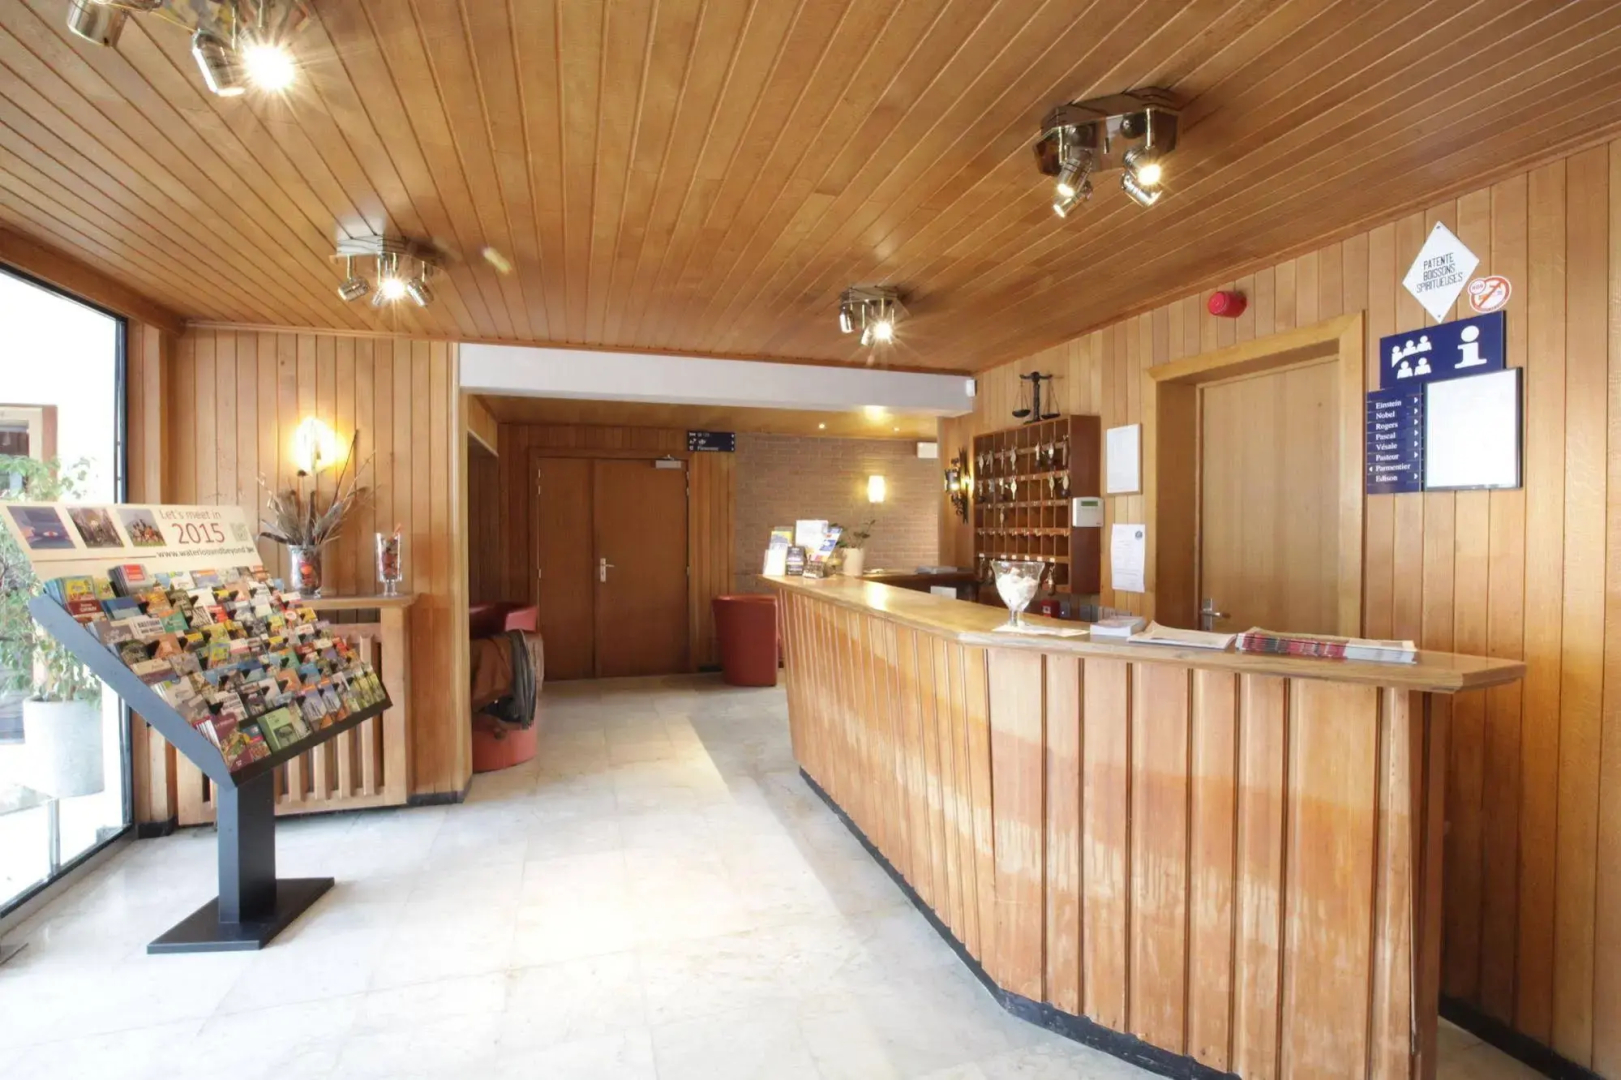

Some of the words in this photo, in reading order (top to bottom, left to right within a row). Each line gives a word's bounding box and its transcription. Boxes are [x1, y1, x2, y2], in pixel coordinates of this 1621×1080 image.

[1423, 252, 1454, 270] PATENTE
[1423, 263, 1455, 281] BOISSONS
[1416, 272, 1463, 293] SPIRITUEUSES
[1375, 400, 1402, 410] Einstein
[1375, 411, 1396, 420] Nobel
[1375, 422, 1399, 431] Rogers
[1375, 432, 1396, 441] Pascal
[1375, 454, 1400, 462] Pasteur
[1375, 463, 1411, 472] Parmentier
[1375, 475, 1398, 483] Edison
[159, 509, 185, 520] Let's
[186, 510, 211, 520] meet
[213, 510, 221, 520] in
[172, 523, 225, 544] 2015
